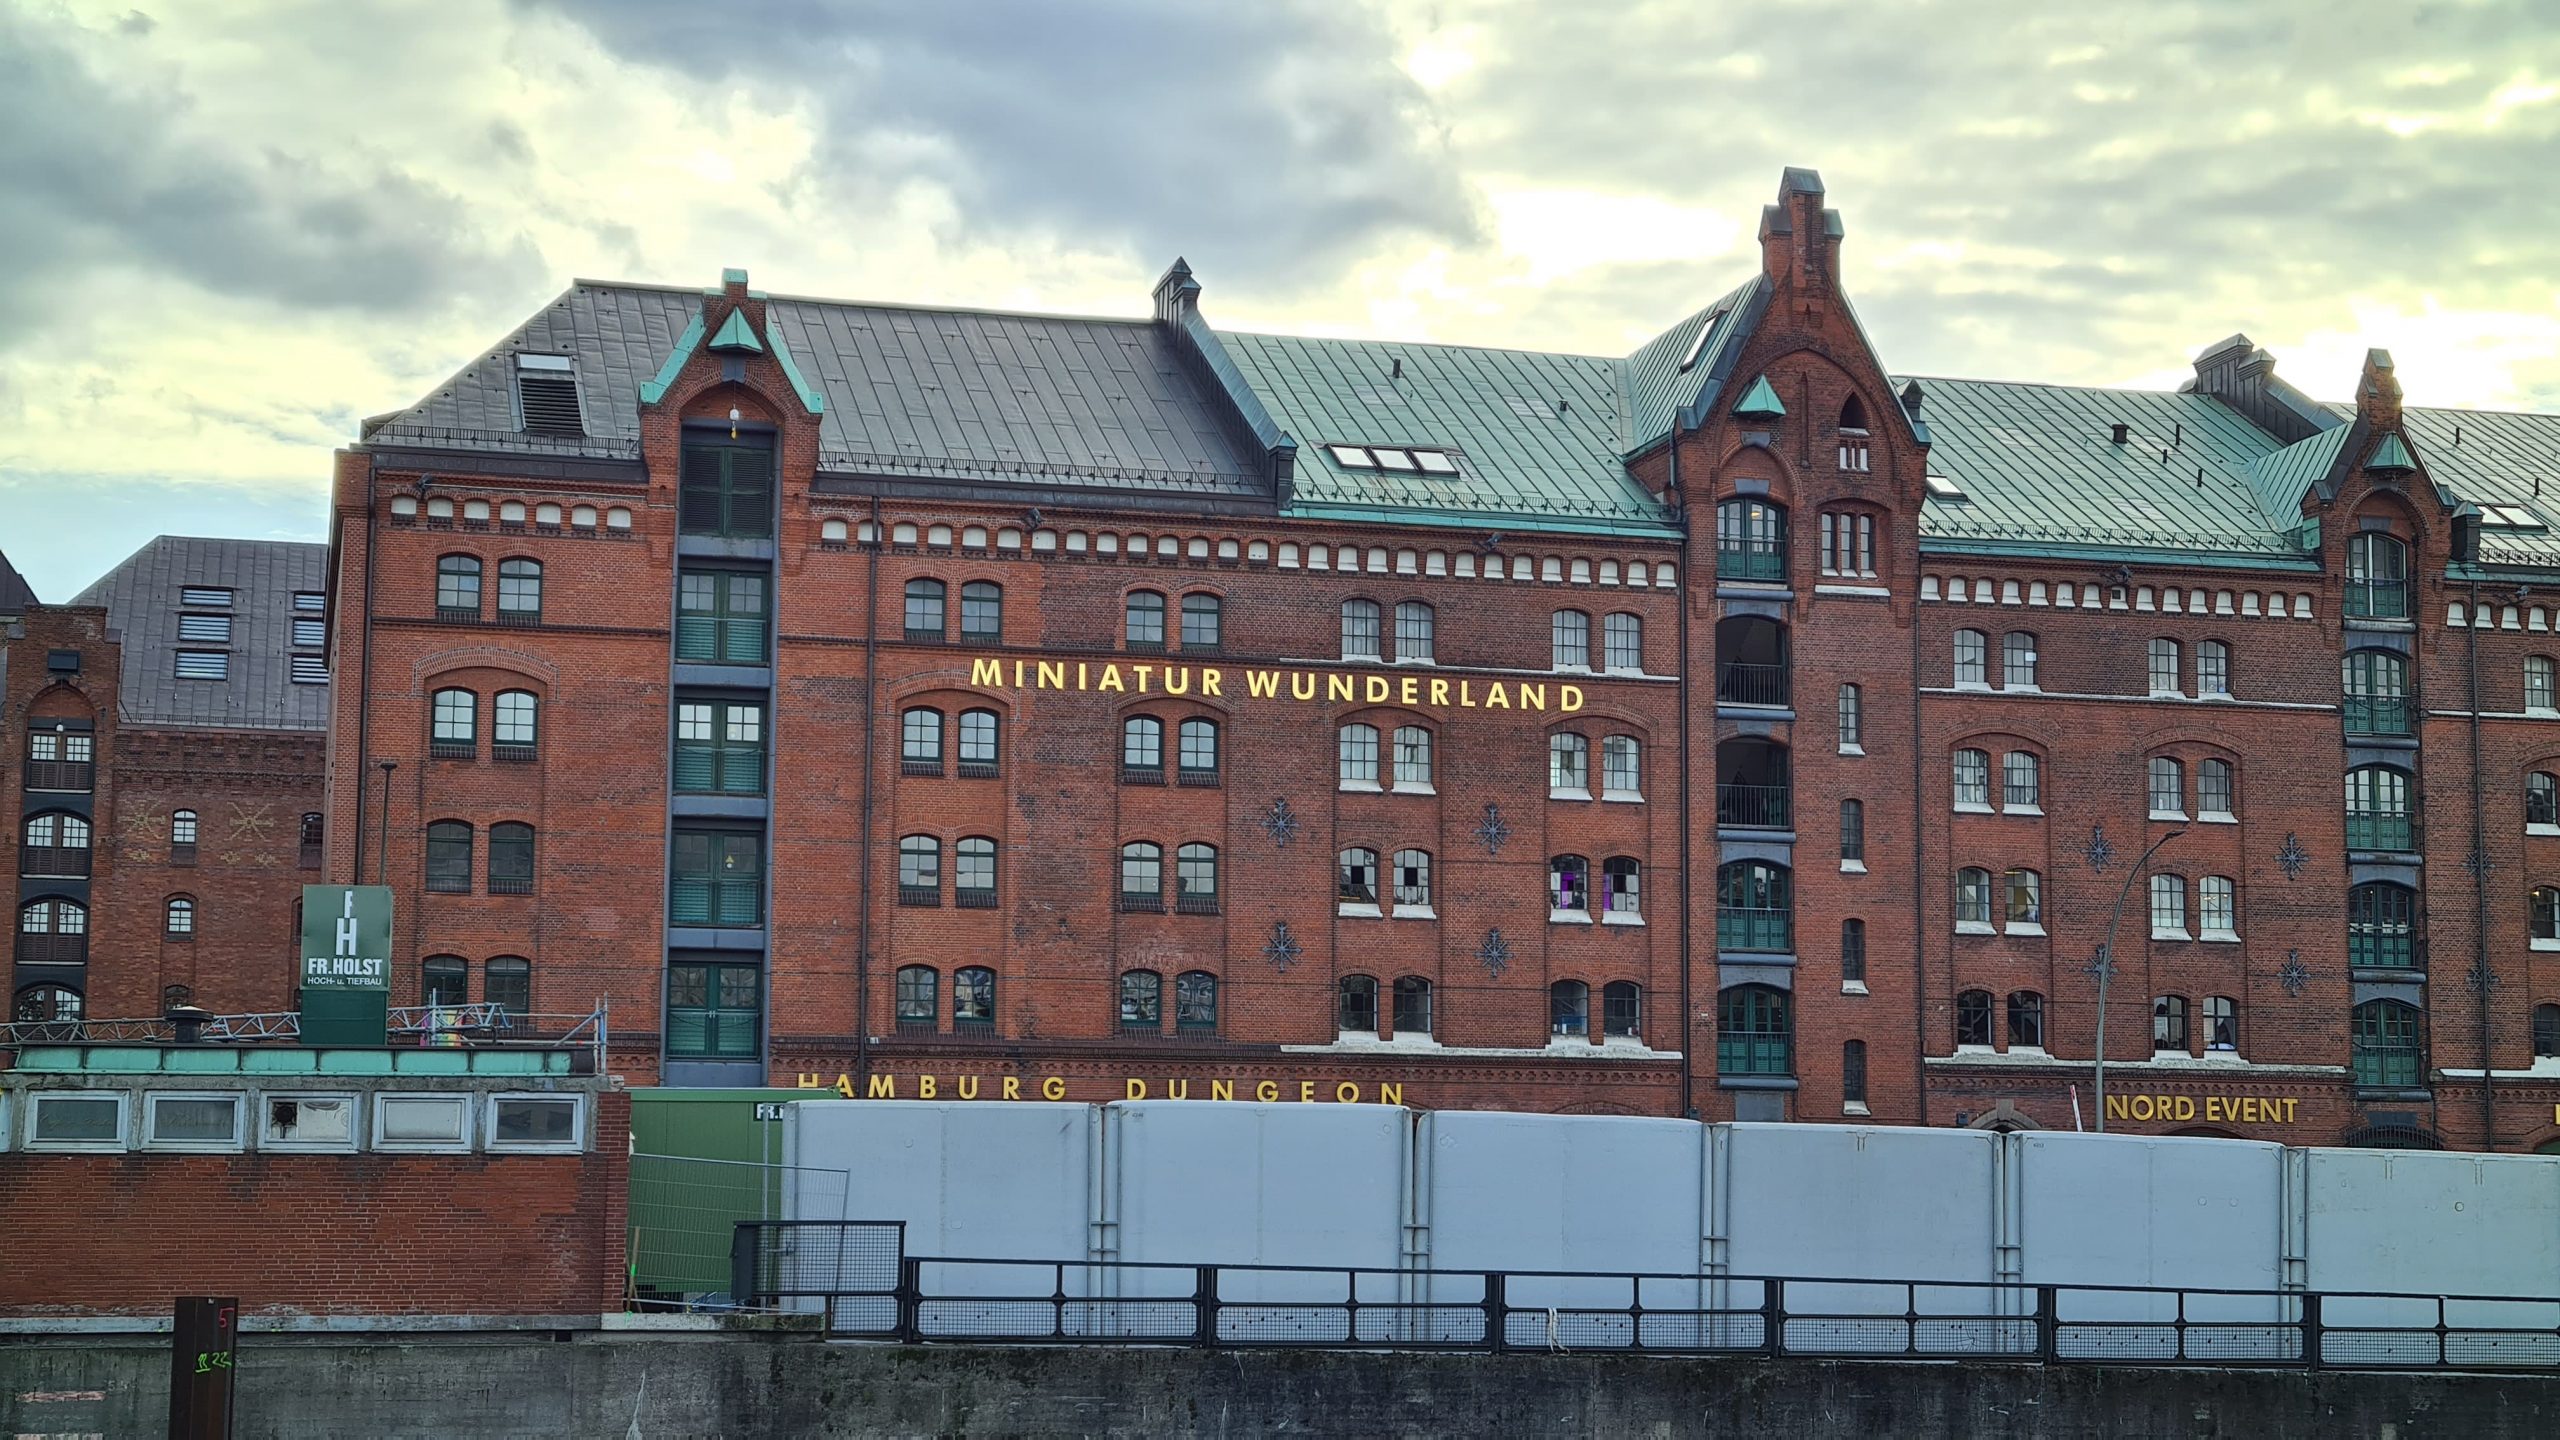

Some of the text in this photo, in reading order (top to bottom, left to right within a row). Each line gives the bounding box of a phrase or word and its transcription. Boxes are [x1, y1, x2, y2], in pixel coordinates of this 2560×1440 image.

[970, 658, 1584, 712] MINIATUR WUNDERLAND
[307, 957, 383, 976] FR.HOLST
[307, 976, 335, 985] HOCH-
[347, 977, 382, 986] TIEFBAU
[797, 1073, 1403, 1105] HAMBURG DUNGEON
[2106, 1094, 2299, 1123] NORD EVENT
